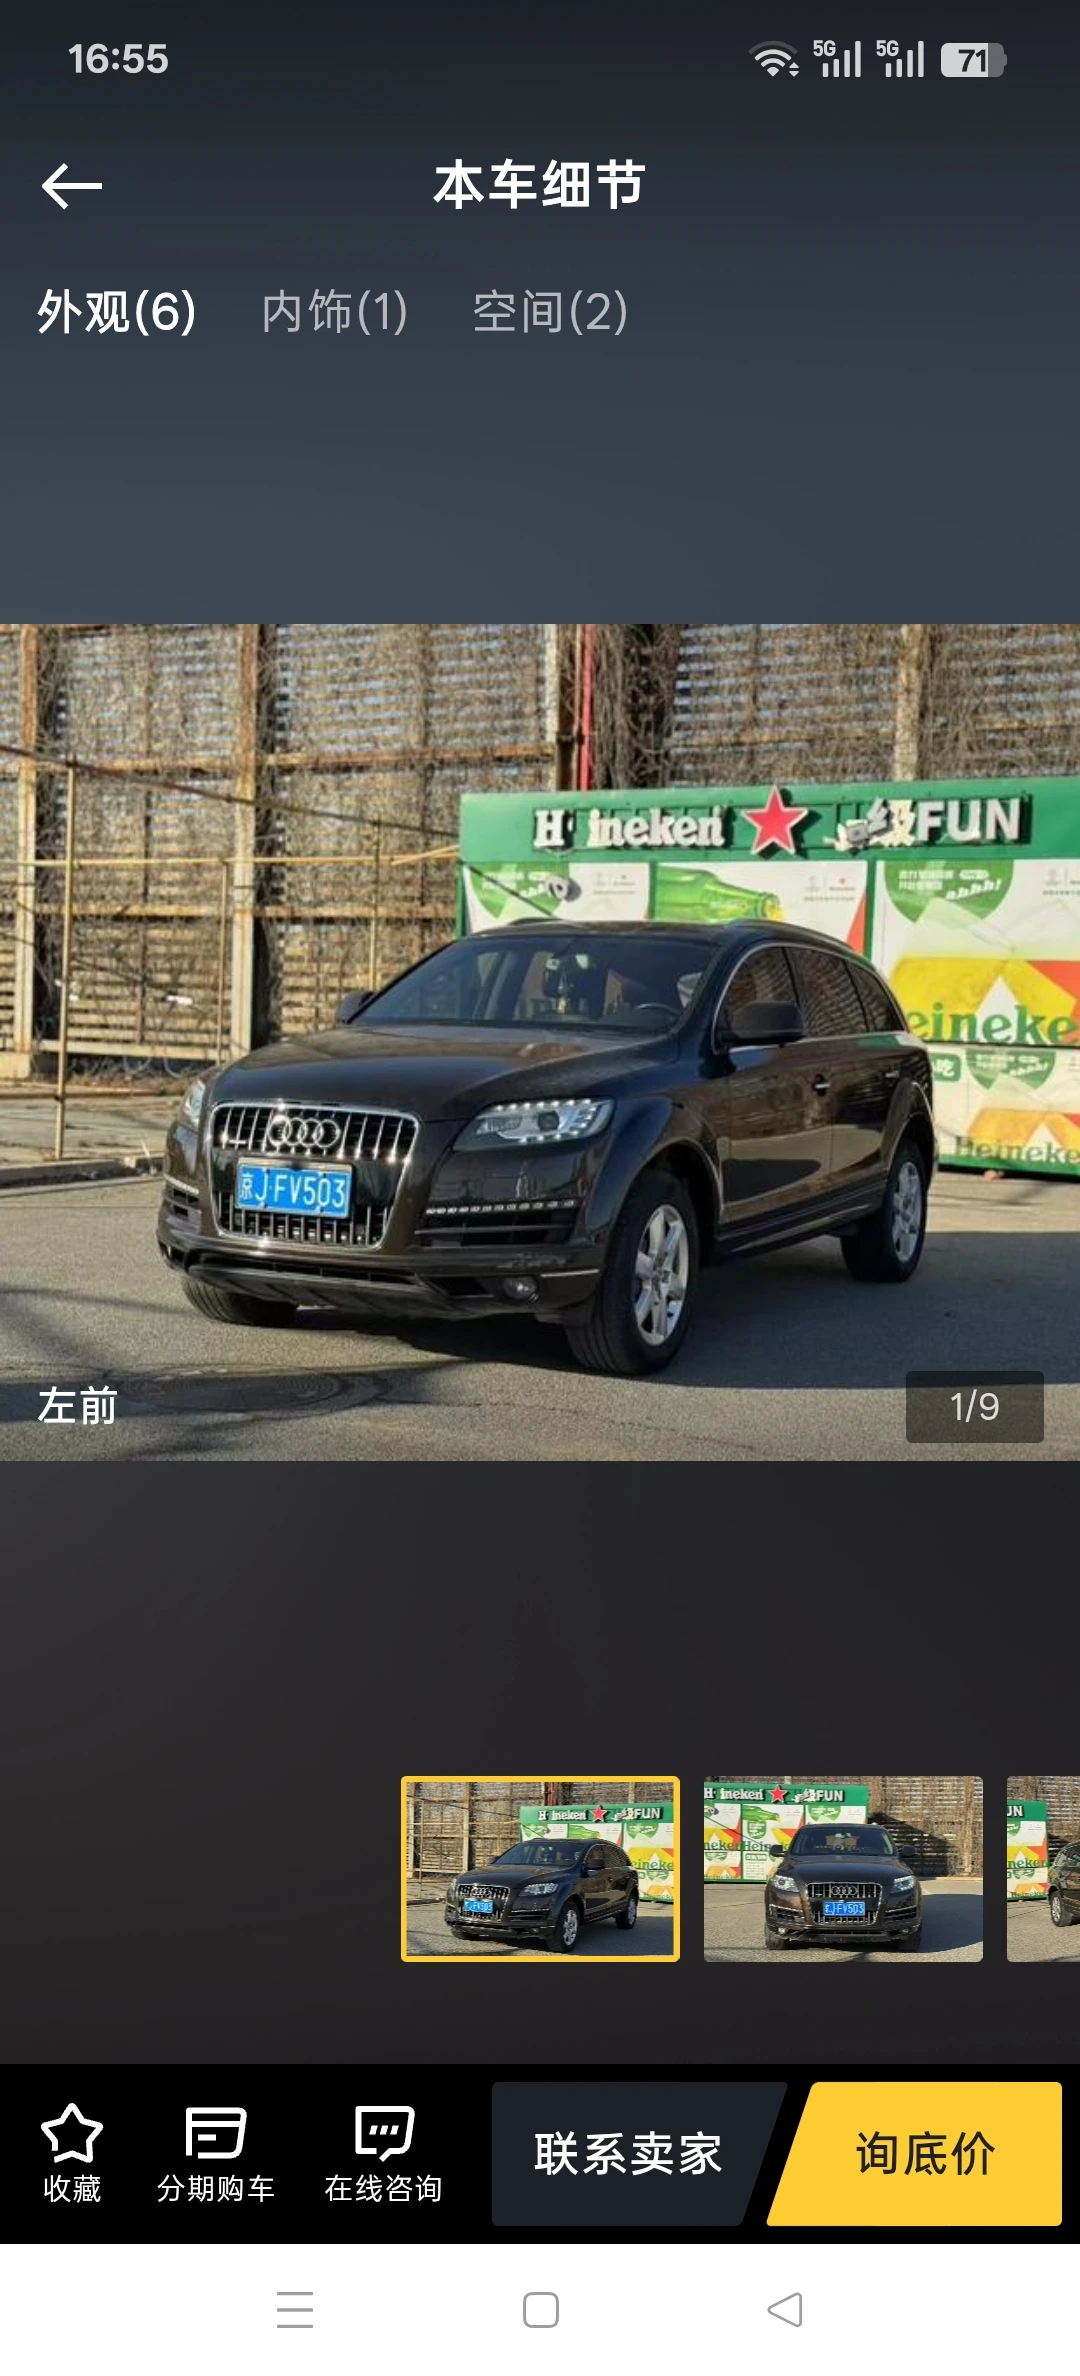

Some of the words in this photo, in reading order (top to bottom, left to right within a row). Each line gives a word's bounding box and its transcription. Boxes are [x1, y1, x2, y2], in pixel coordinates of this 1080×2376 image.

[68, 44, 169, 74] 16:55
[813, 39, 837, 57] 5G
[876, 39, 900, 57] 5G
[958, 49, 987, 73] 71
[432, 158, 647, 210] 本车细节
[36, 288, 196, 337] 外观(6)
[263, 288, 408, 336] 内饰(1)
[473, 288, 628, 336] 空间(2)
[533, 805, 725, 848] Hineken
[36, 1384, 118, 1426] 左前
[949, 1387, 1001, 1424] 1/9
[533, 2130, 723, 2176] 联系卖家
[856, 2130, 996, 2176] 询底价
[43, 2174, 102, 2203] 收藏
[157, 2173, 275, 2203] 分期购车
[324, 2173, 442, 2203] 在线咨询
